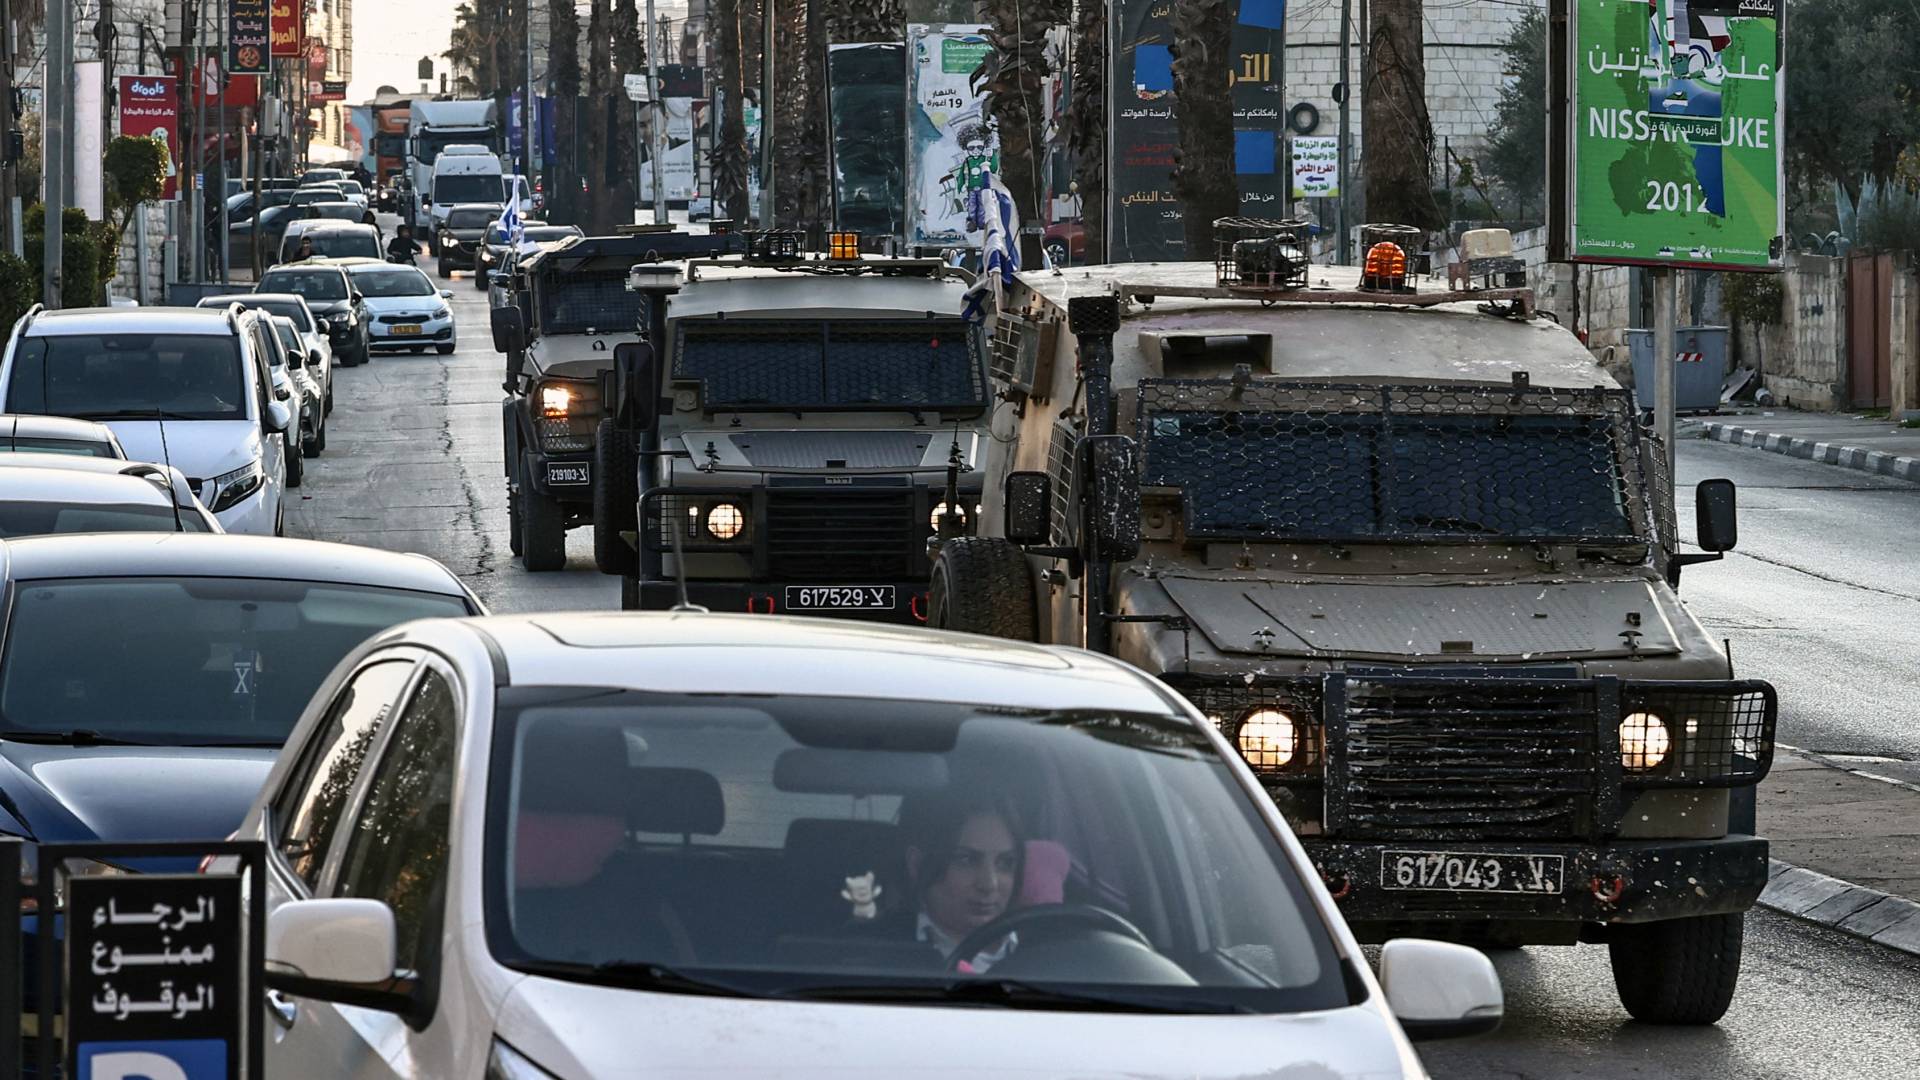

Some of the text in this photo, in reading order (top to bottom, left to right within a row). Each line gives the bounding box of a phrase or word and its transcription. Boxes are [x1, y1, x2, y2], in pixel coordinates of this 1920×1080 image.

[131, 81, 165, 95] drools
[948, 98, 963, 108] 19
[1262, 193, 1275, 203] من
[92, 896, 215, 931] الرجاء
[91, 936, 214, 975] ممنوع
[92, 981, 214, 1020] الوقوف
